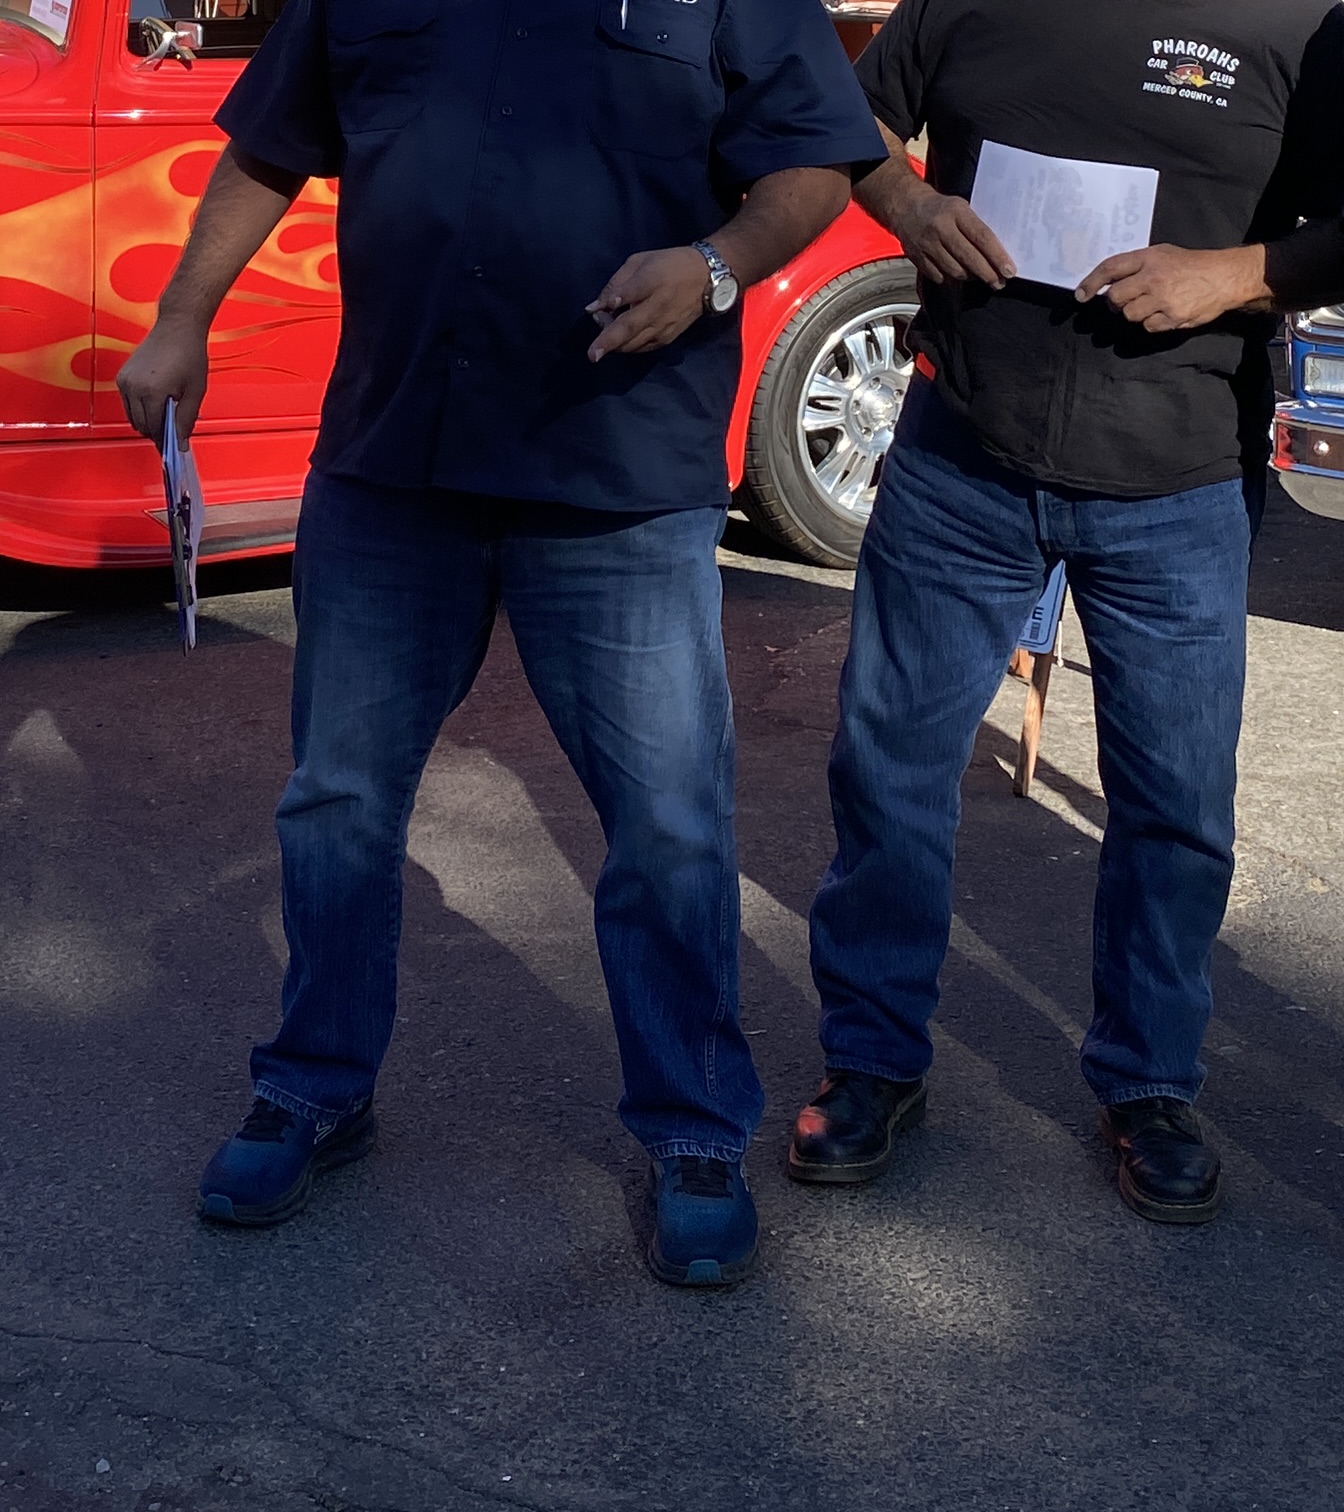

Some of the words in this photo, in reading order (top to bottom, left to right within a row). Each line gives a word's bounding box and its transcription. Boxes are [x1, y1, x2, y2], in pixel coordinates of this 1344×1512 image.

[1152, 38, 1240, 72] PHAROAHS
[1147, 57, 1168, 70] CAR
[1209, 70, 1235, 85] CLUB
[1142, 82, 1177, 96] MERCED
[1215, 97, 1228, 108] CA
